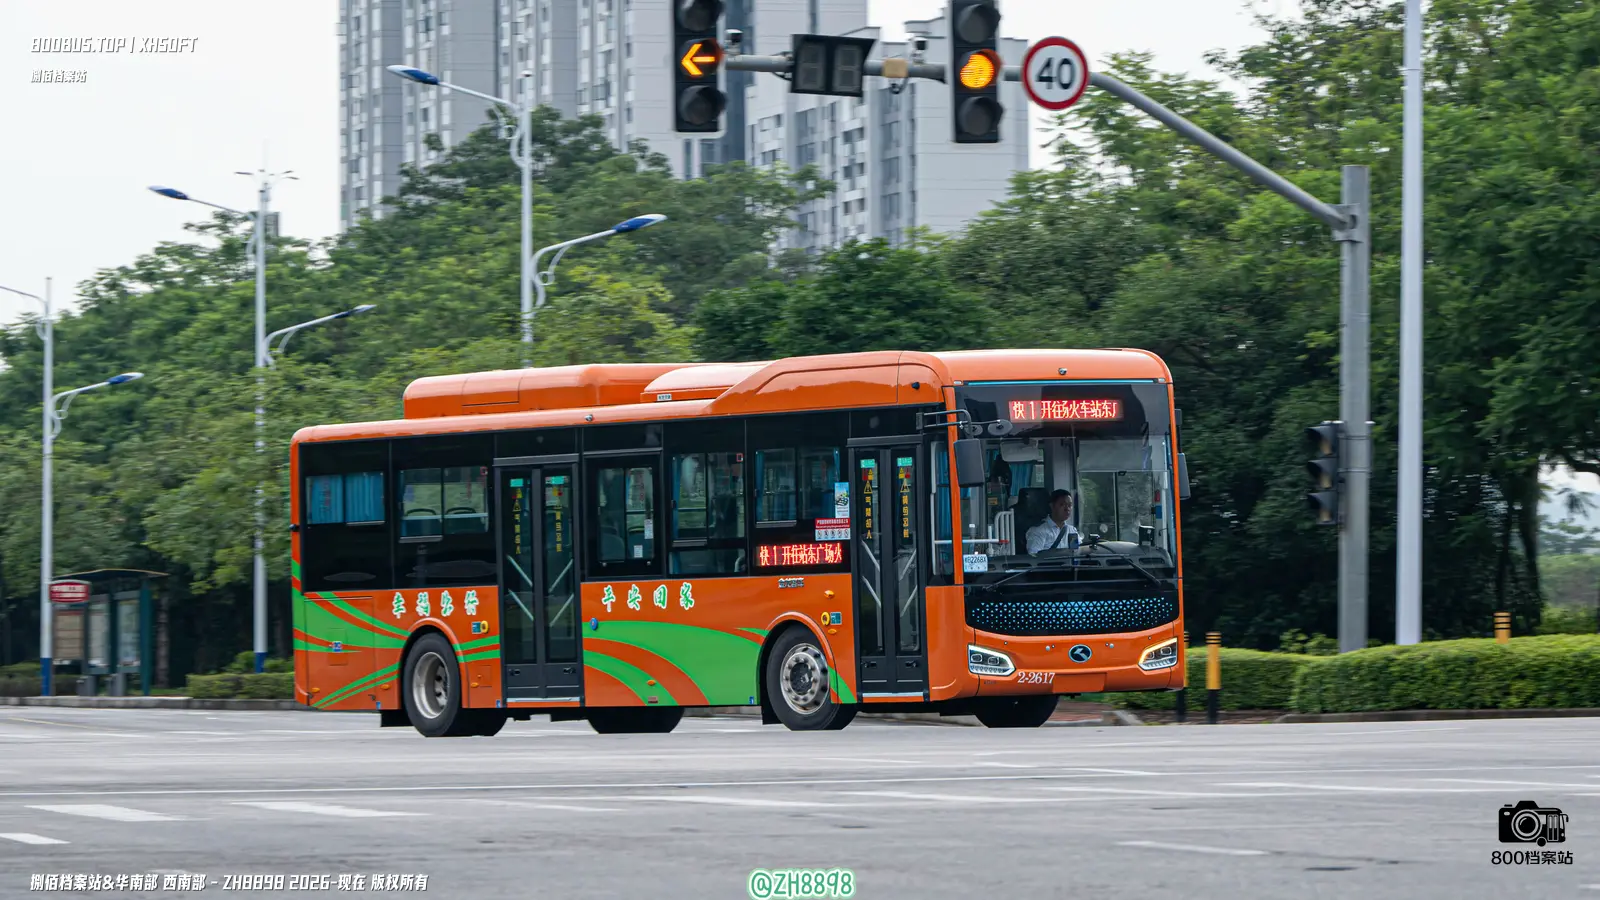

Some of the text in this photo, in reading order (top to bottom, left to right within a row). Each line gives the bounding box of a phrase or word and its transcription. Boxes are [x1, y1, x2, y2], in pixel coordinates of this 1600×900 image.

[1035, 57, 1076, 90] 40
[1012, 401, 1026, 420] 快
[1029, 401, 1036, 420] 1
[759, 545, 770, 566] 快
[392, 590, 479, 619] 幸福出行
[601, 582, 695, 613] 平安回家
[1017, 671, 1056, 684] 2-2617
